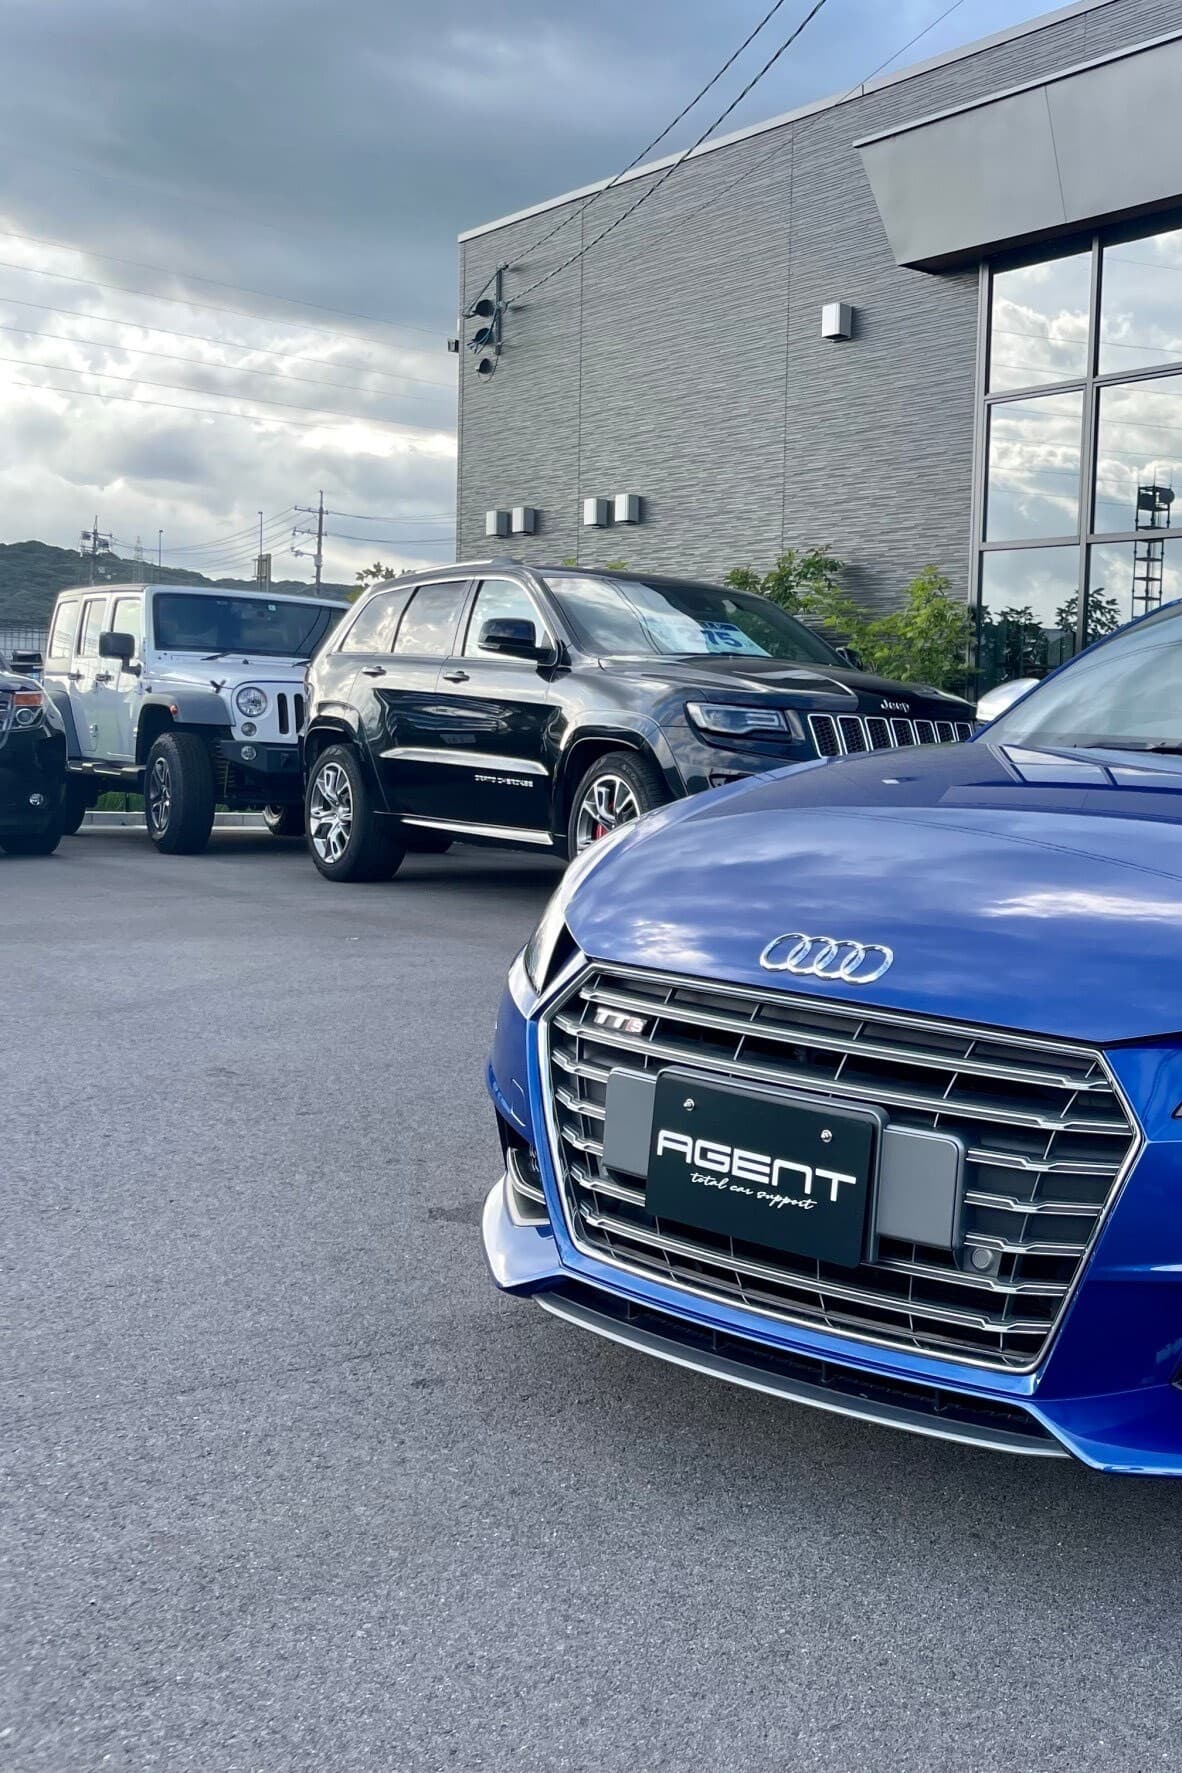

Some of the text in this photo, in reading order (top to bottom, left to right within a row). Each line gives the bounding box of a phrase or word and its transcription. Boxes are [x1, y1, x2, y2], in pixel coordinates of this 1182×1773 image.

[656, 1129, 857, 1202] AGENT
[690, 1172, 818, 1210] total car support
